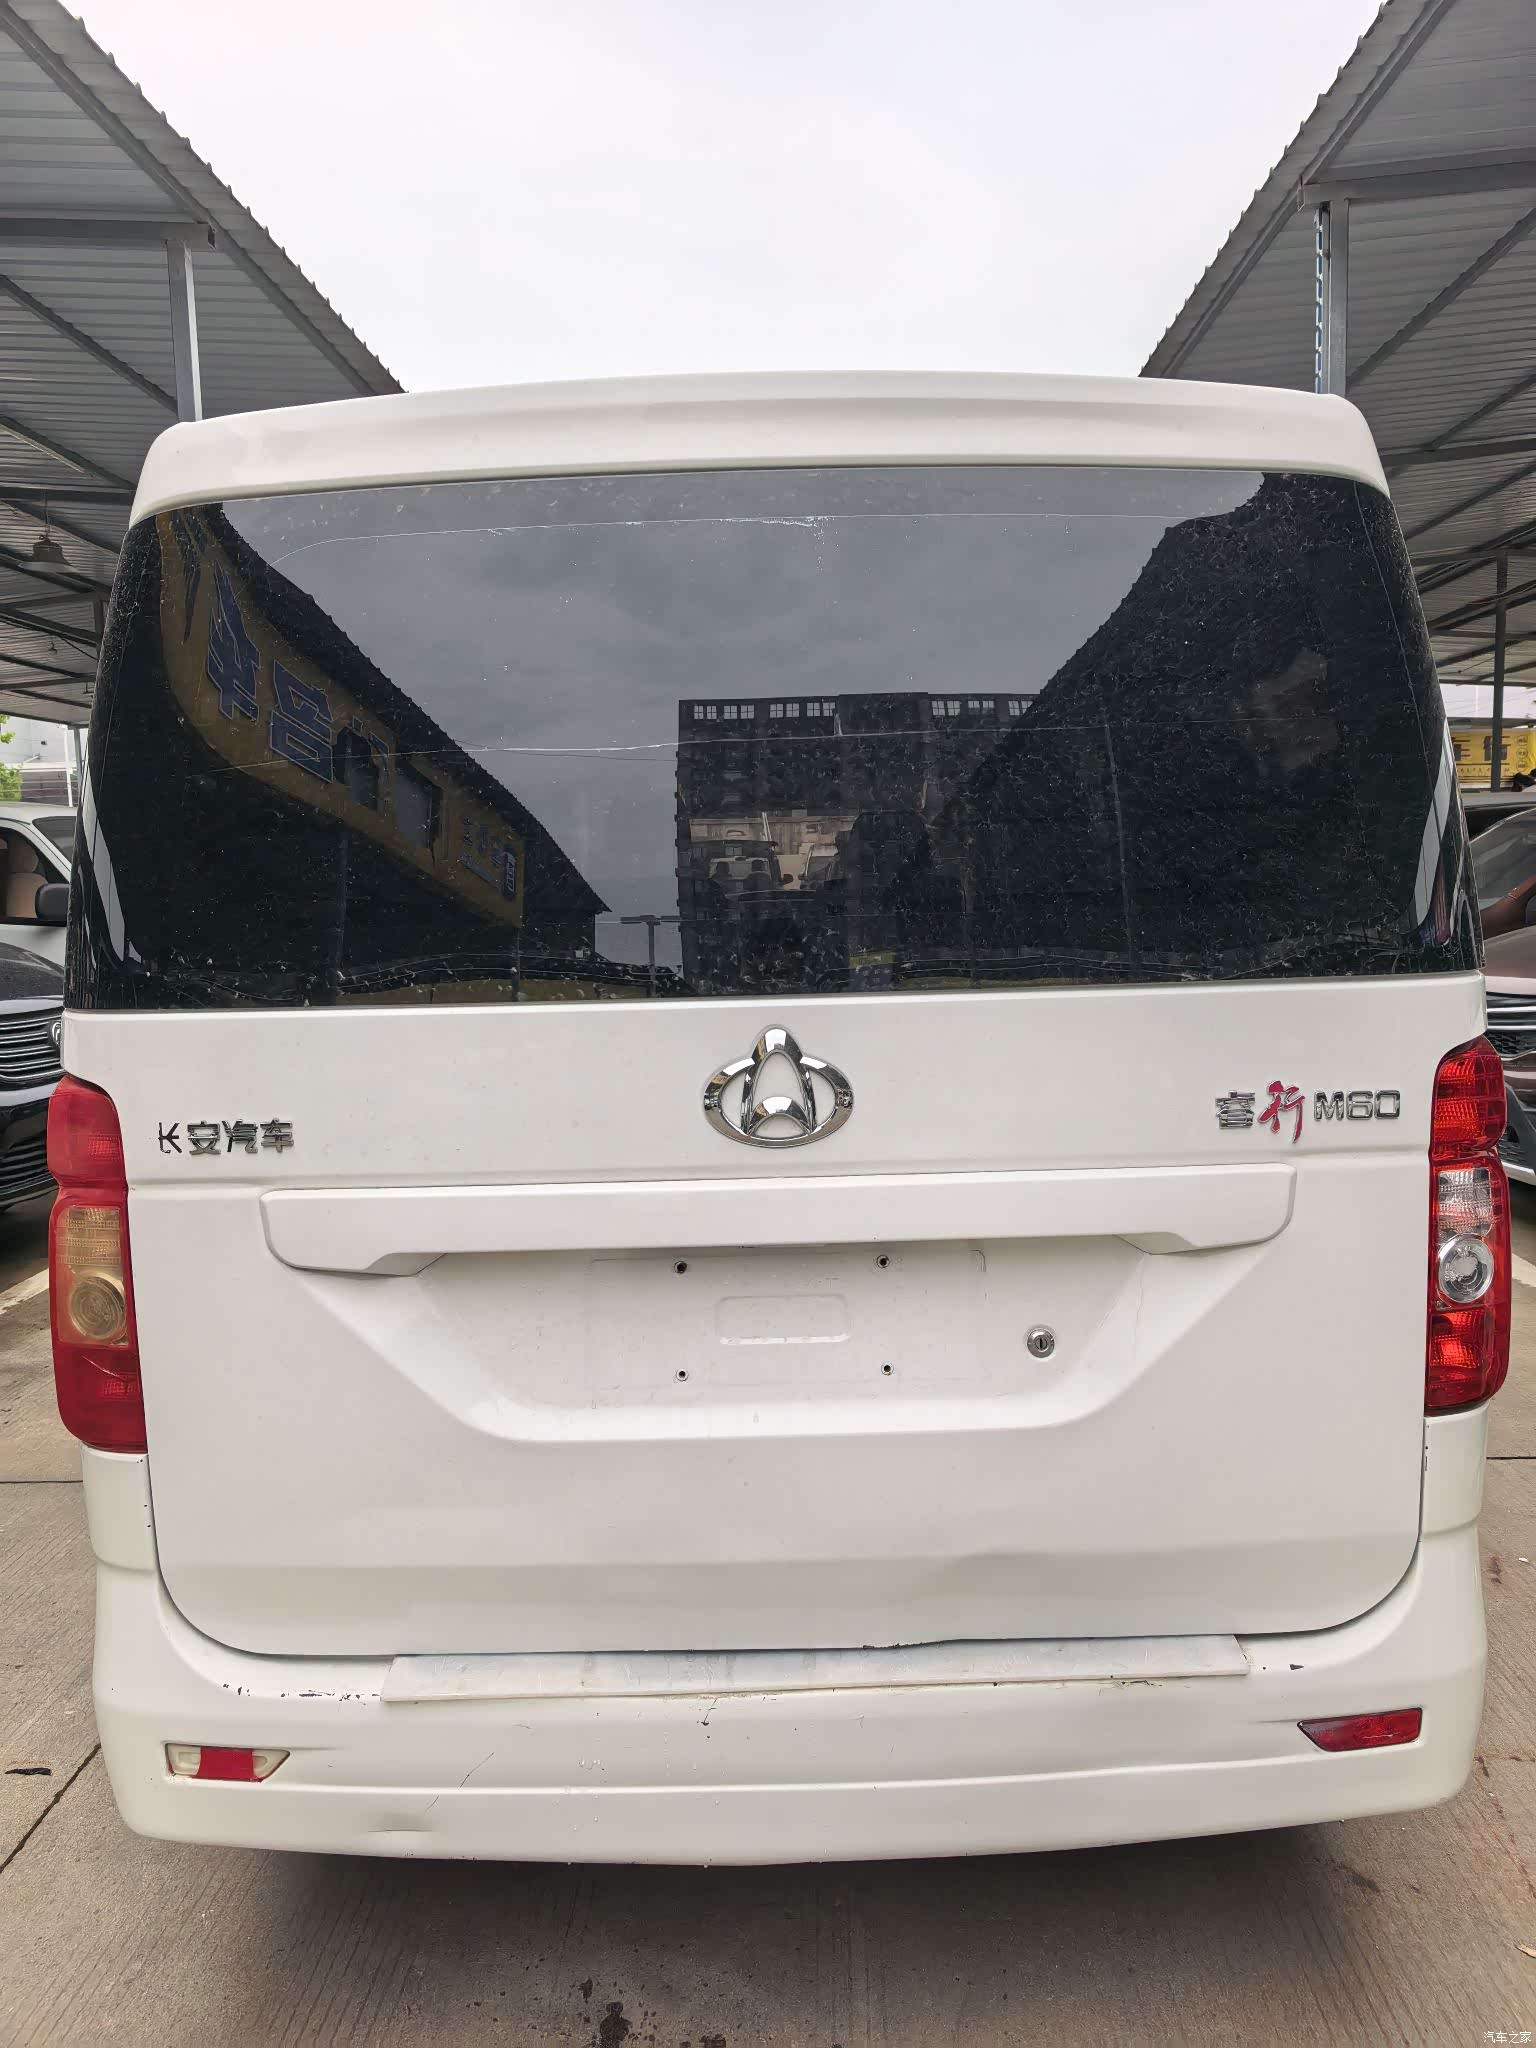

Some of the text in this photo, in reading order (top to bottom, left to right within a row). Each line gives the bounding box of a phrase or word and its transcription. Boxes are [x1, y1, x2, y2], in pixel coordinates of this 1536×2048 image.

[158, 1118, 294, 1155] 长安汽车
[1214, 1080, 1401, 1145] 睿行 M60
